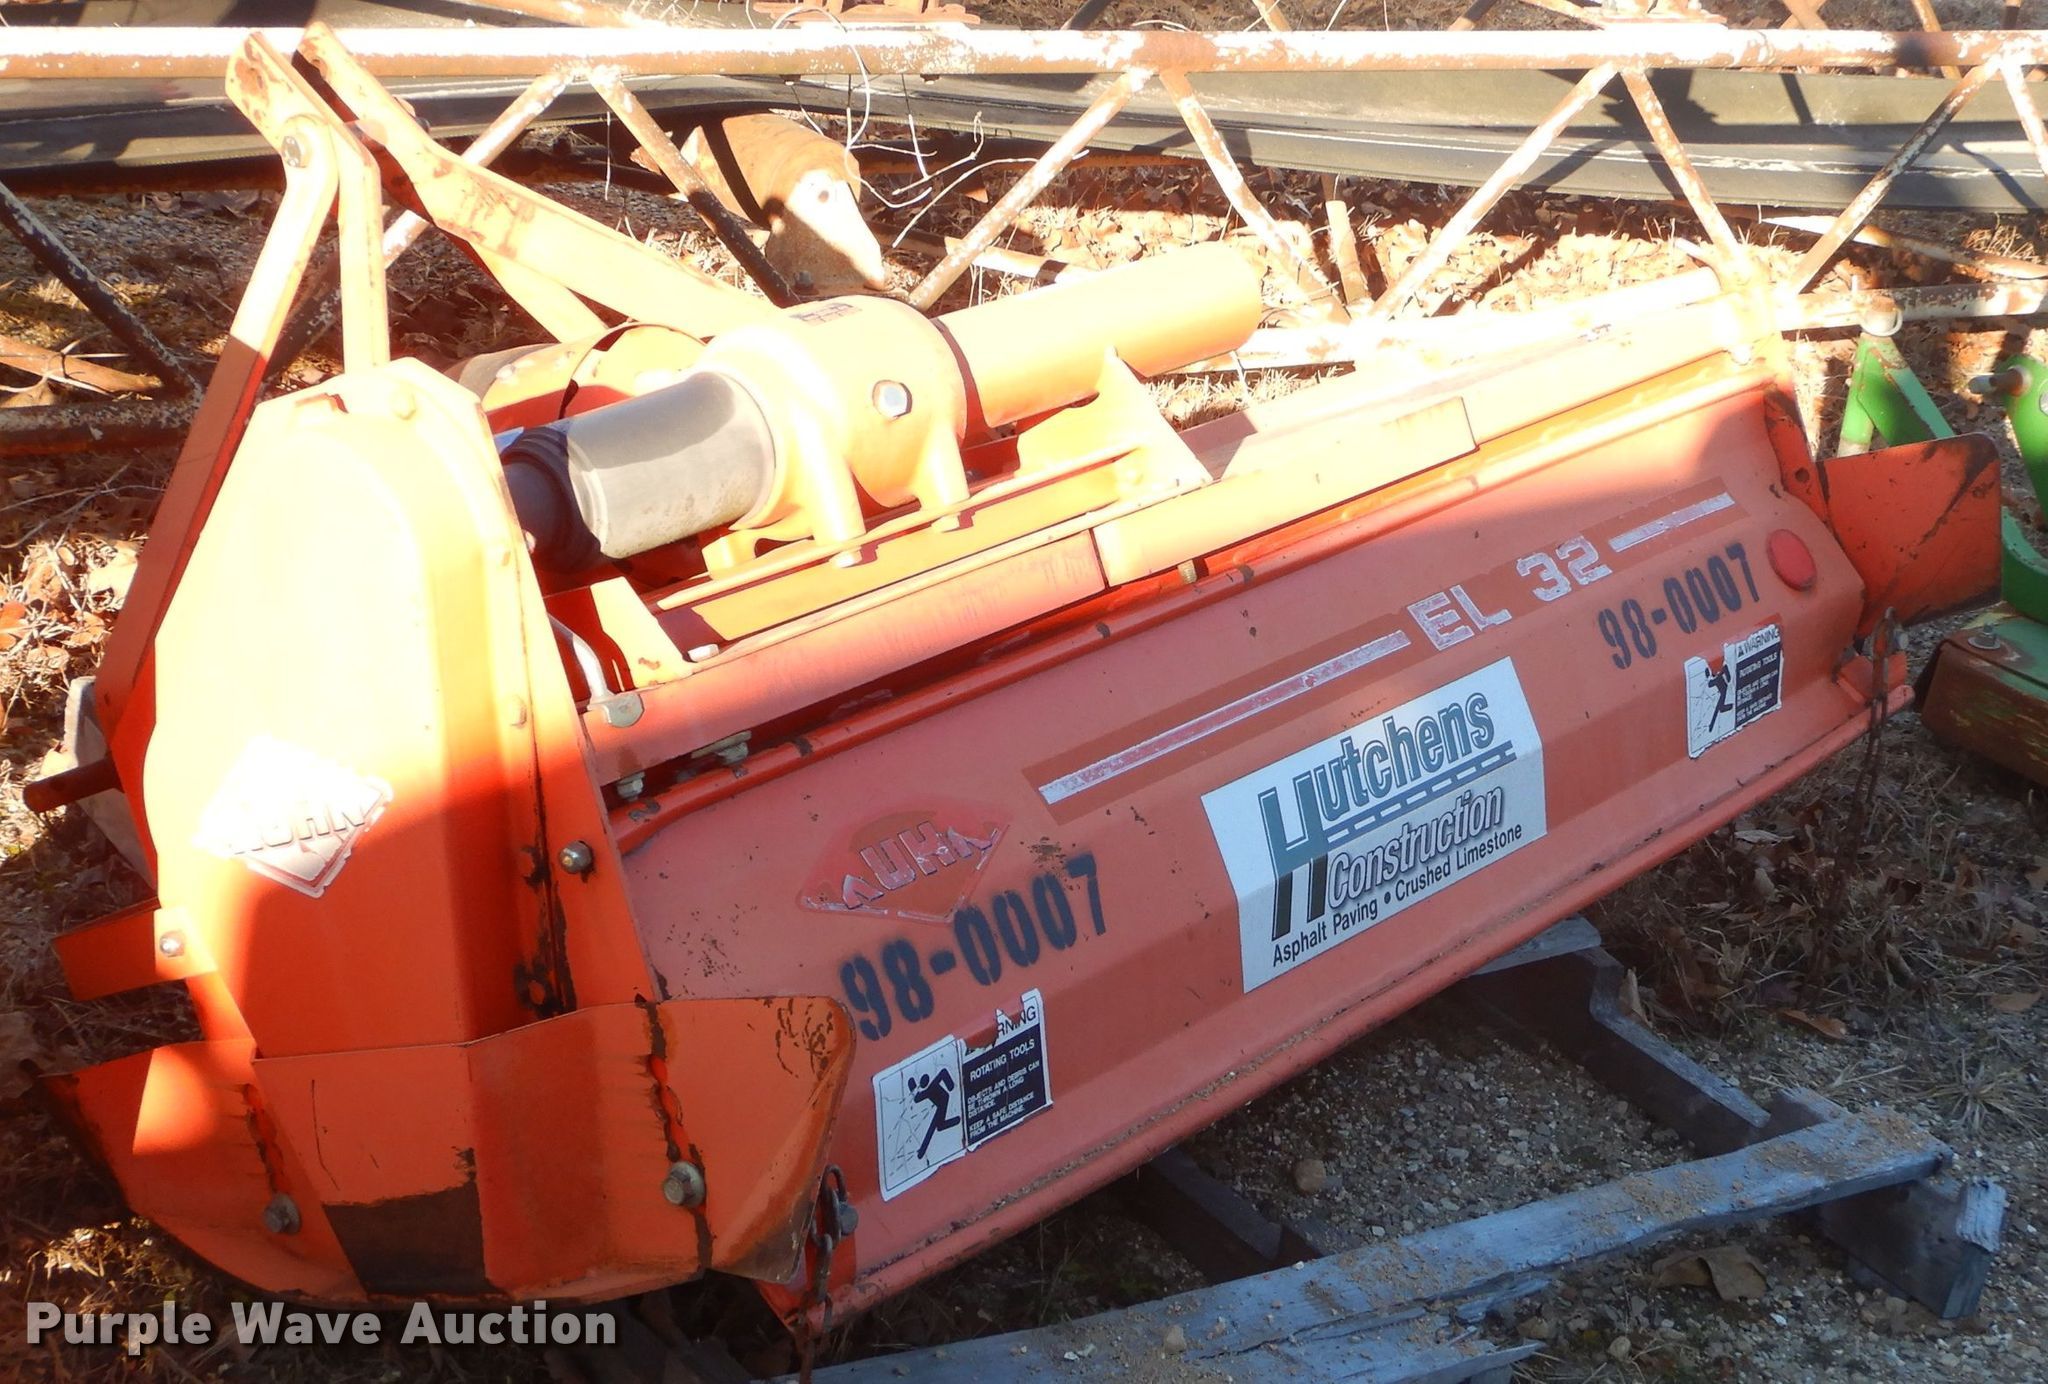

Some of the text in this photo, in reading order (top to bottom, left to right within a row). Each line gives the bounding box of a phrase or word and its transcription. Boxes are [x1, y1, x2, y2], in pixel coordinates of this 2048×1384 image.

[1407, 535, 1612, 650] EL 32
[1598, 542, 1759, 670] 98-0007
[1257, 692, 1496, 941] Hutchens
[1327, 786, 1503, 909] Construction
[839, 853, 1106, 1040] 98-0007
[1273, 823, 1522, 967] Asphalt Paving Crushed Limestone
[970, 1039, 1035, 1082] ROTATING TOOLS
[985, 1115, 991, 1123] A
[994, 1079, 1005, 1092] AND
[1028, 1060, 1040, 1072] CAN
[1003, 1085, 1008, 1094] A
[1008, 1076, 1024, 1090] LONG
